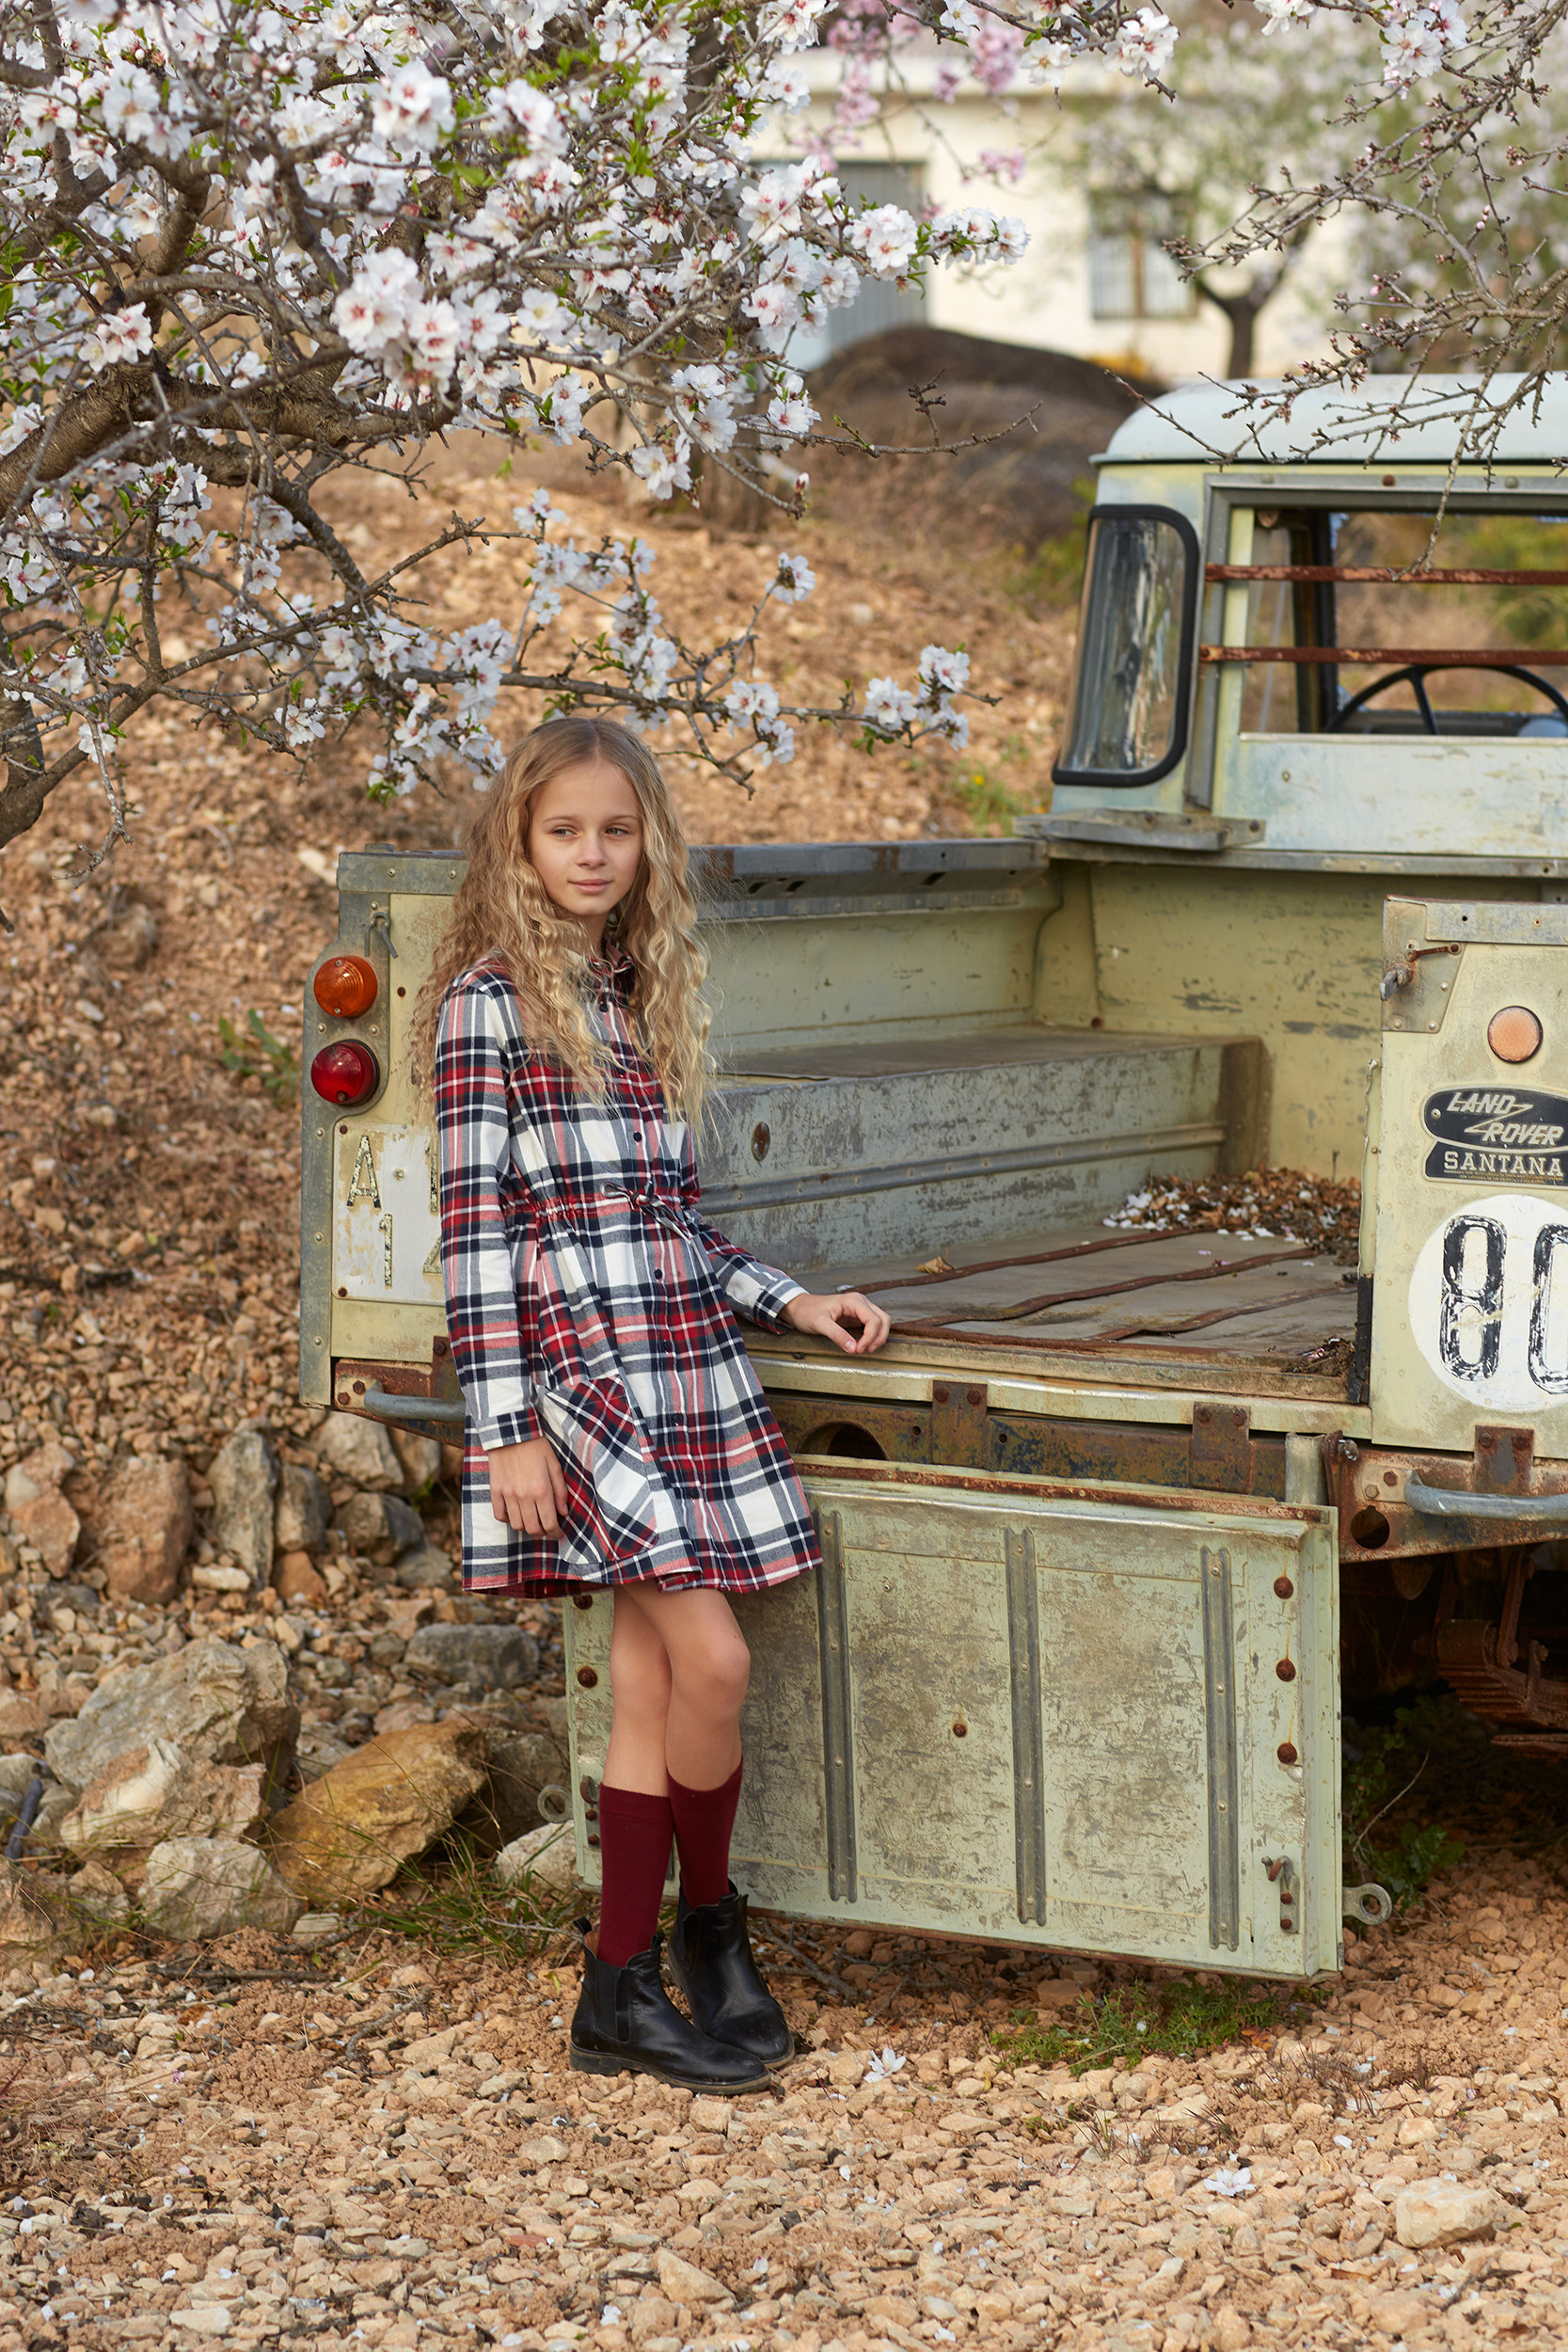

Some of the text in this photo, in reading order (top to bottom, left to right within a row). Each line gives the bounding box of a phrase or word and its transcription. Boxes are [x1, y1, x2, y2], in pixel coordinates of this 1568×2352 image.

[1447, 1092, 1516, 1114] LAND
[1482, 1122, 1564, 1145] ROVER
[346, 1135, 382, 1209] A
[1444, 1151, 1564, 1177] SANTANA
